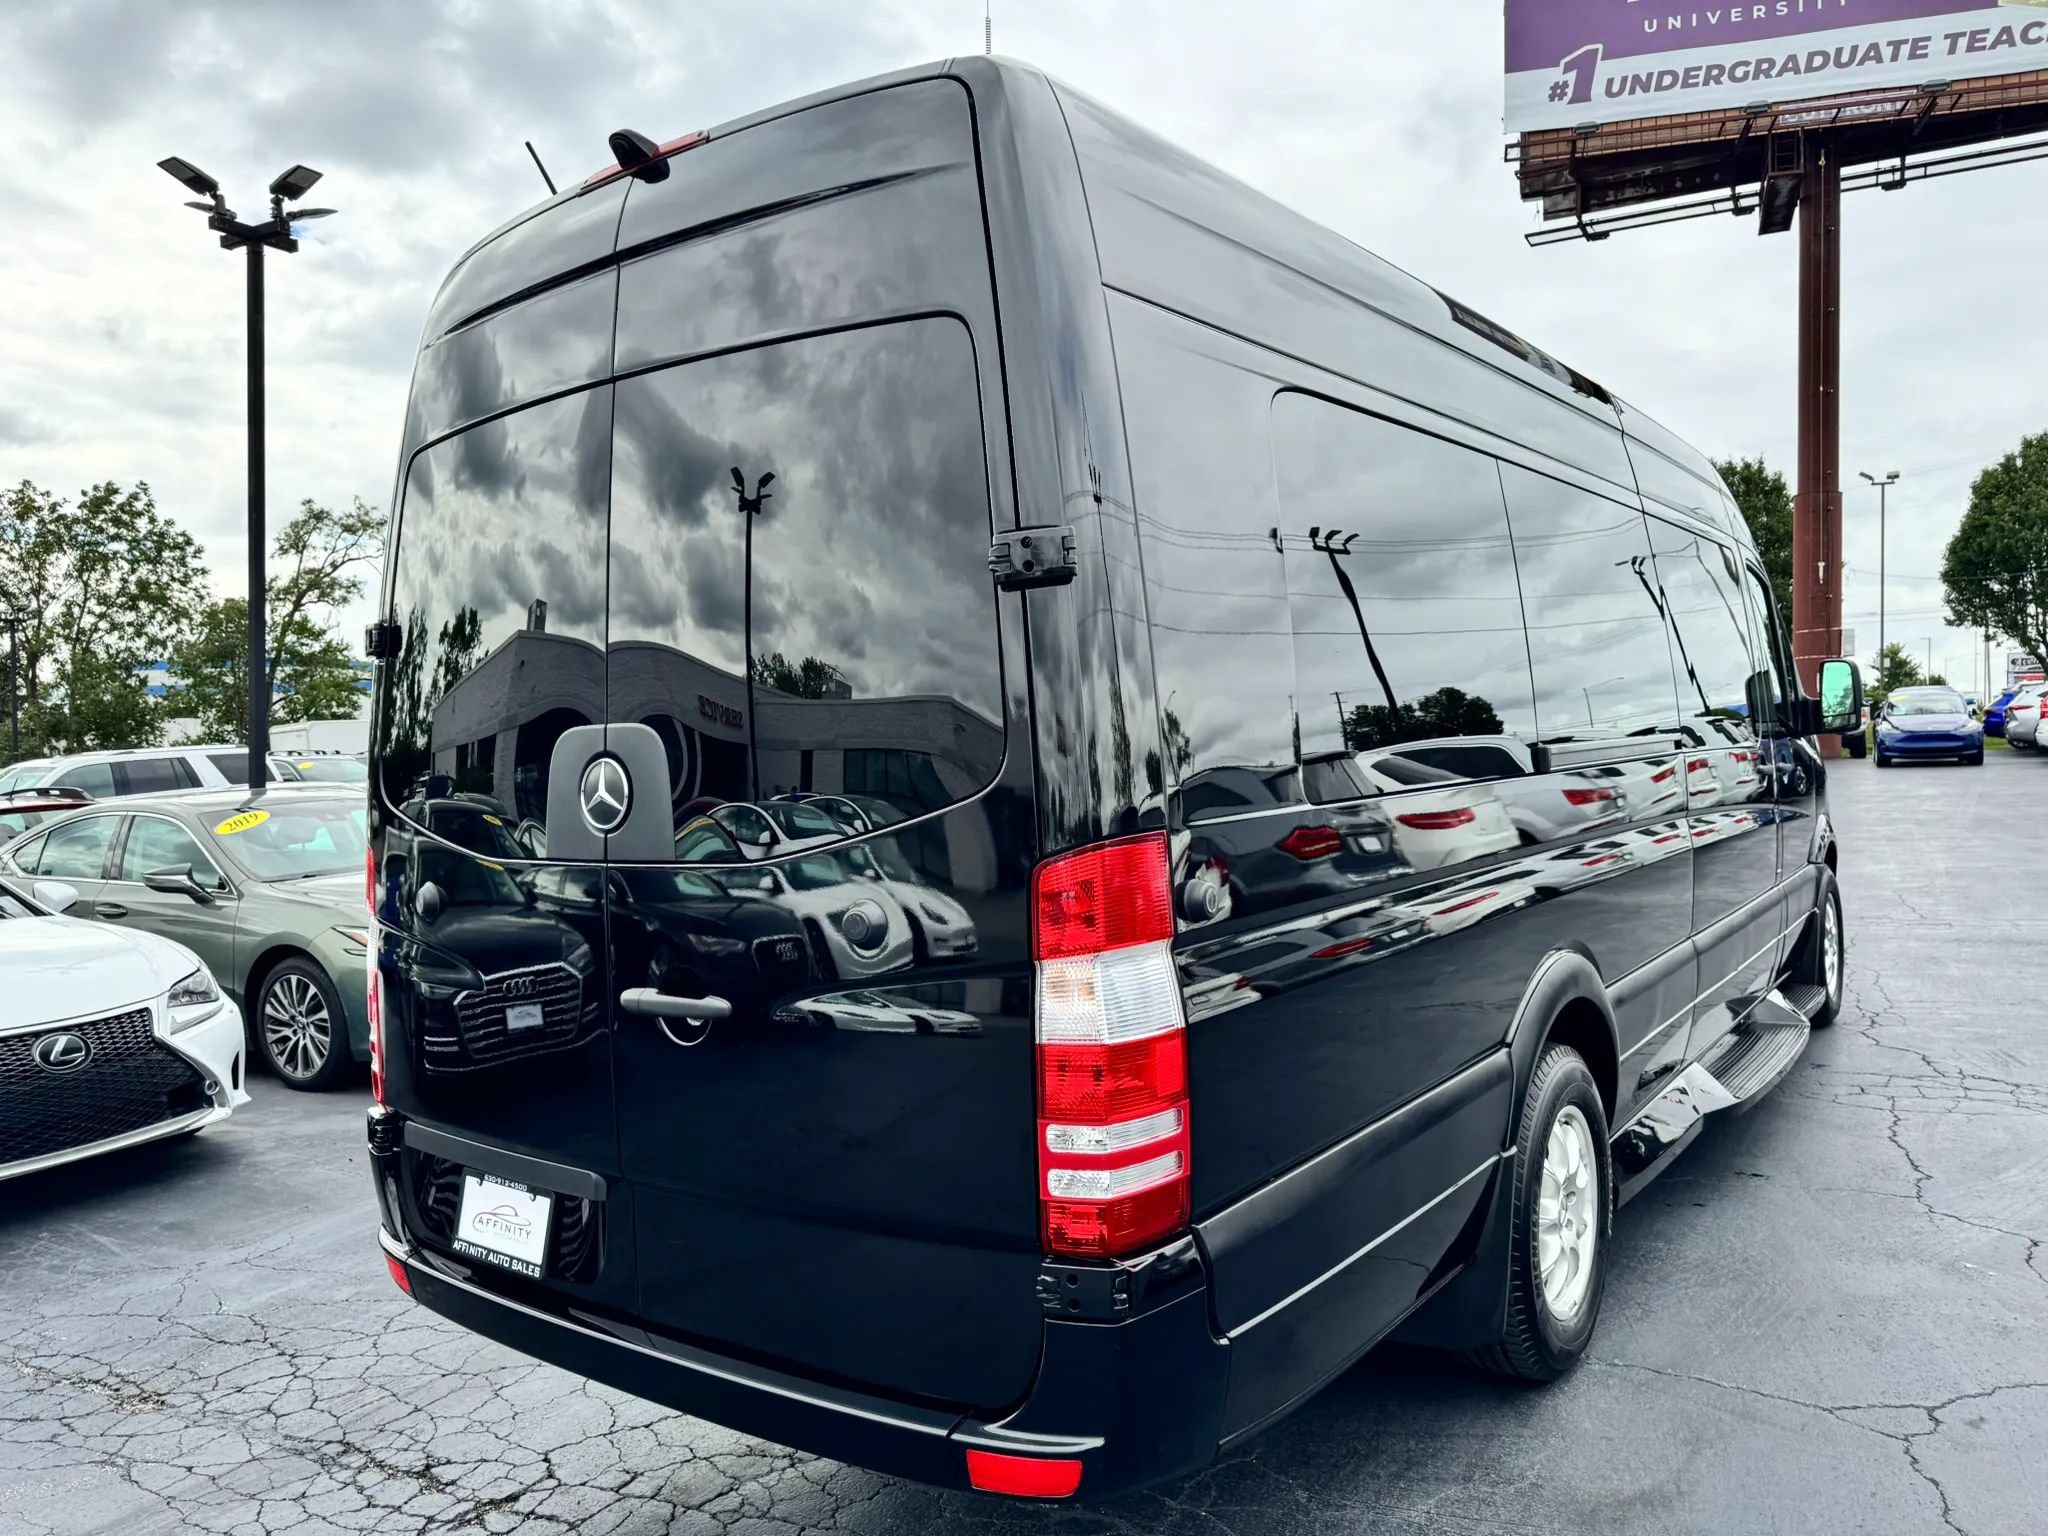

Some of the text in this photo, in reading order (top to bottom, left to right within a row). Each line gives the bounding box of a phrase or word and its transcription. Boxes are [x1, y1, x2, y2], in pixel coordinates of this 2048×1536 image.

[1604, 35, 1932, 98] UNDERGRADUATE
[1943, 21, 2048, 56] TEAC
[224, 812, 258, 832] 2019
[477, 1215, 532, 1240] AFFINITY
[452, 1239, 541, 1278] AFFINITY AUTO SALES
